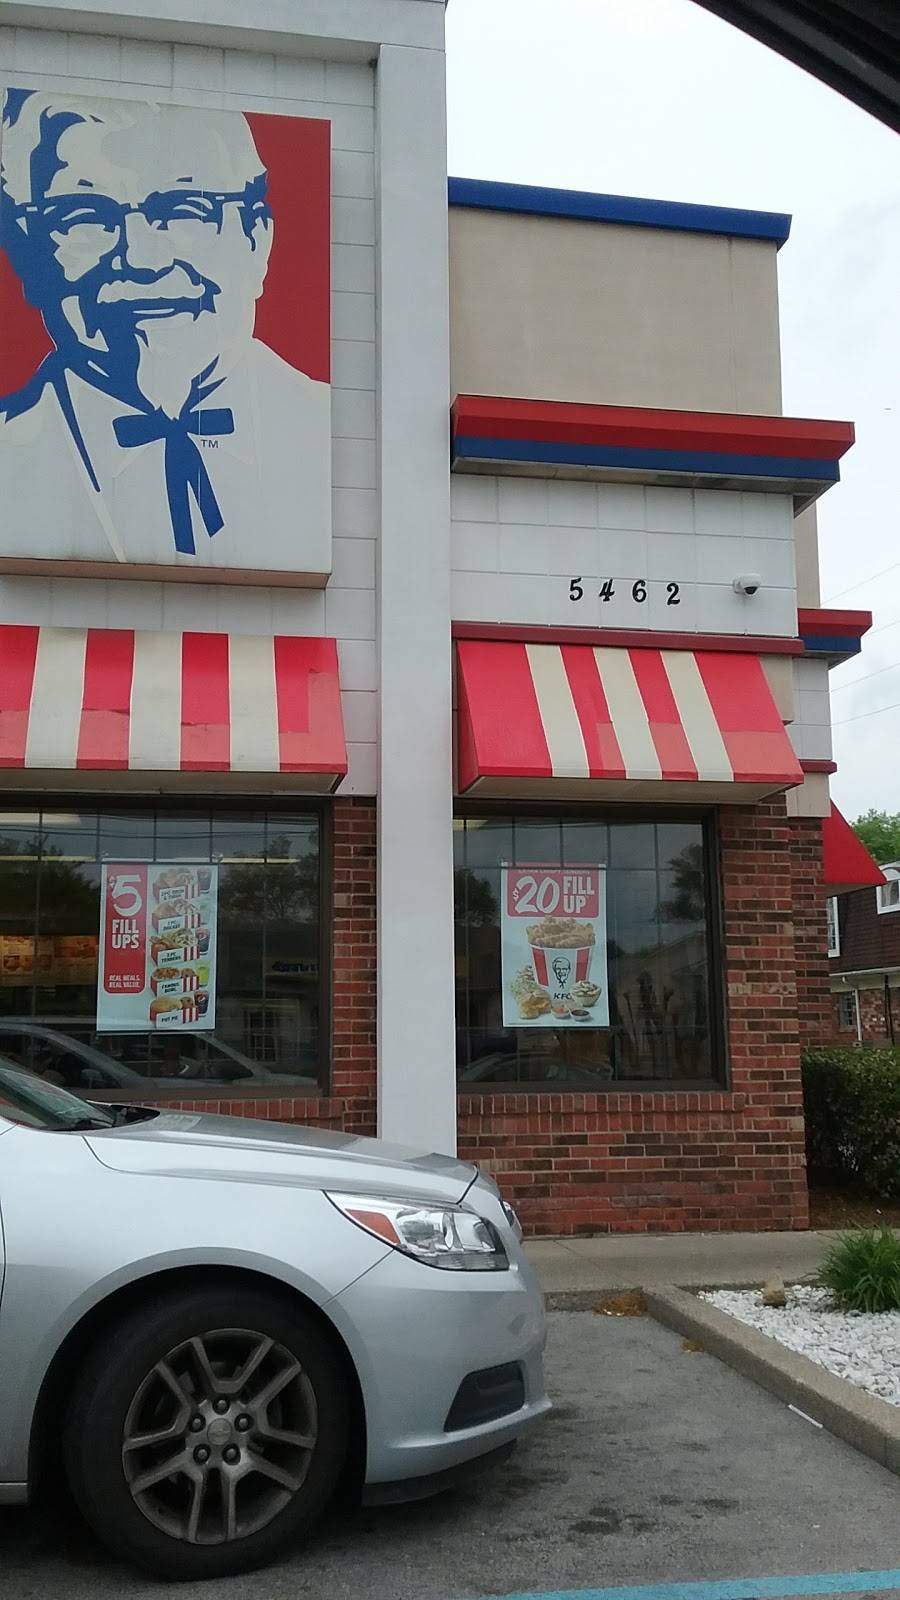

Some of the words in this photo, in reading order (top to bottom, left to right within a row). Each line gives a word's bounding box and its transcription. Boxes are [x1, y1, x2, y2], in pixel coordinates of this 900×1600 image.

[201, 440, 219, 449] TM
[563, 876, 595, 896] FILL
[512, 876, 560, 914] $20
[563, 895, 586, 914] UP
[112, 919, 140, 934] FILL
[112, 934, 139, 949] UPS
[553, 992, 573, 1000] KFC
